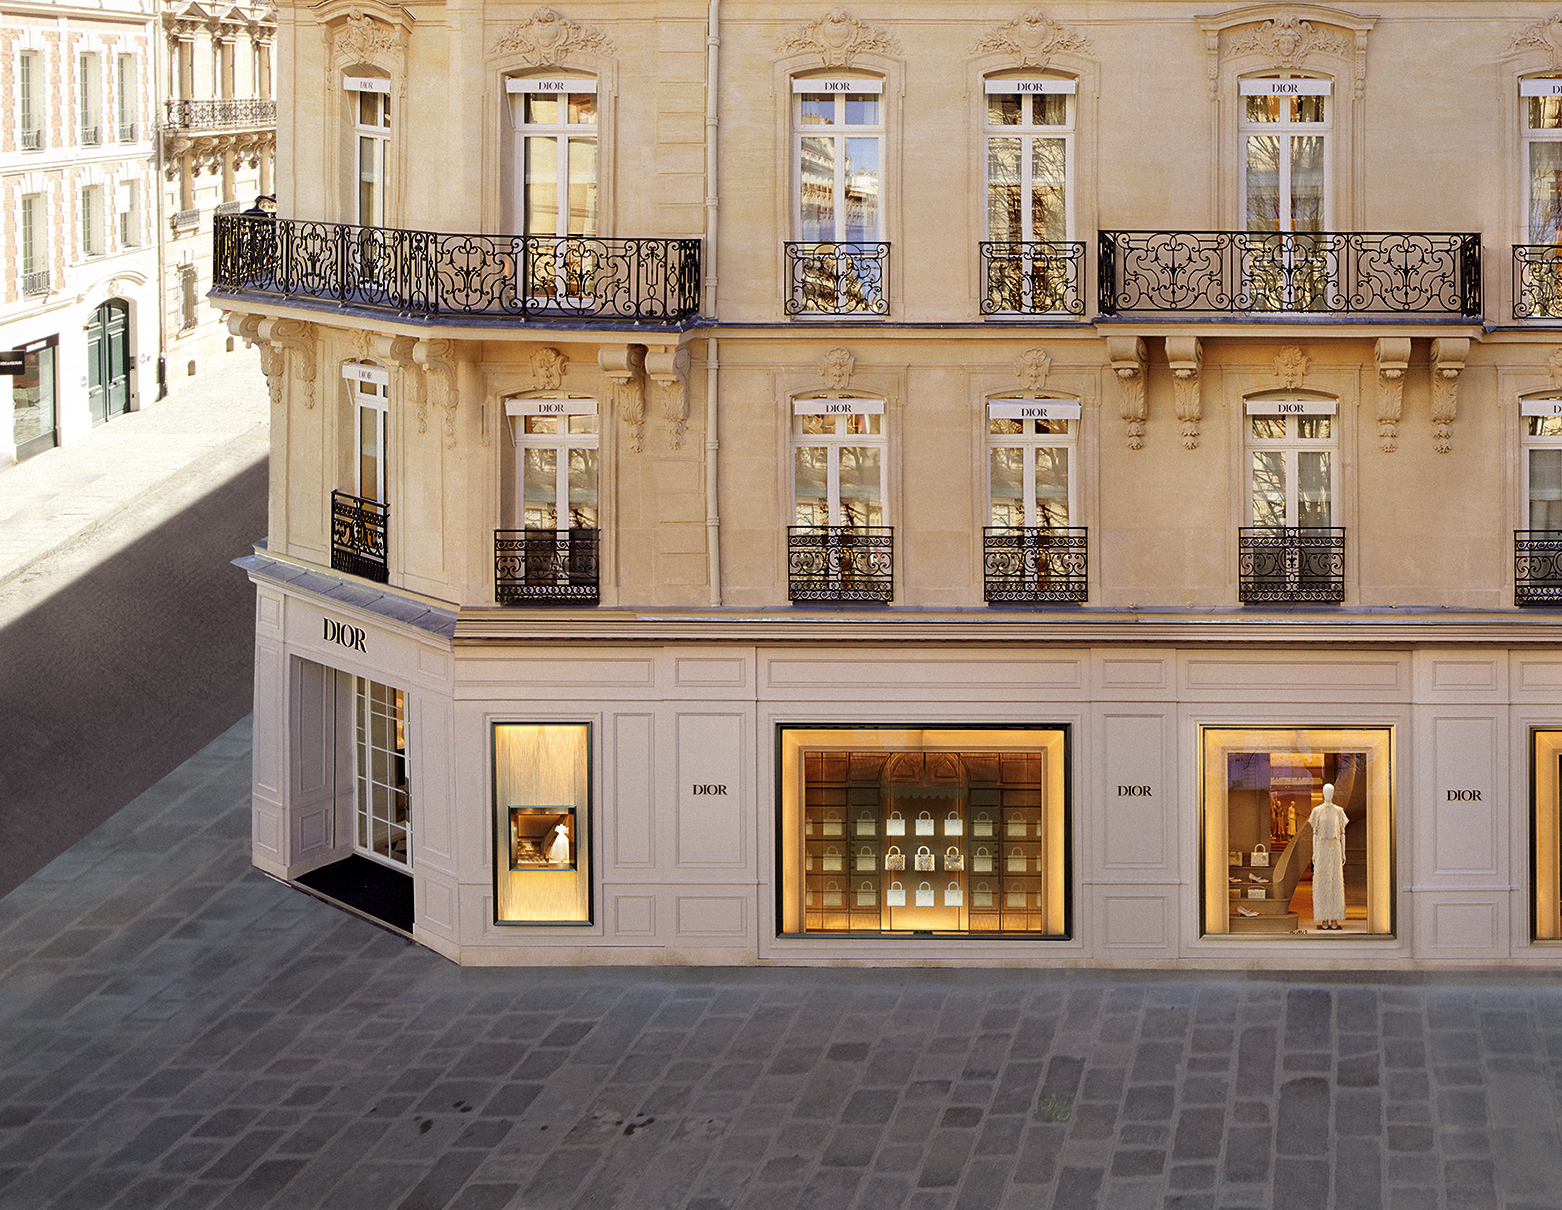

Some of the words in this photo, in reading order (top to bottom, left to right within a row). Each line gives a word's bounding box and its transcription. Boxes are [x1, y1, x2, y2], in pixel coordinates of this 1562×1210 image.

[360, 80, 373, 90] DIOR
[538, 82, 564, 90] DIOR
[824, 83, 850, 91] DIOR
[1017, 83, 1043, 91] DIOR
[1272, 84, 1298, 92] DIOR
[357, 369, 371, 380] DIOR
[538, 404, 564, 412] DIOR
[826, 404, 852, 413] DIOR
[1021, 408, 1047, 417] DIOR
[1278, 404, 1304, 413] DIOR
[323, 617, 368, 654] DIOR
[692, 784, 728, 796] DIOR
[1117, 785, 1153, 797] DIOR
[1447, 789, 1482, 801] DIOR
